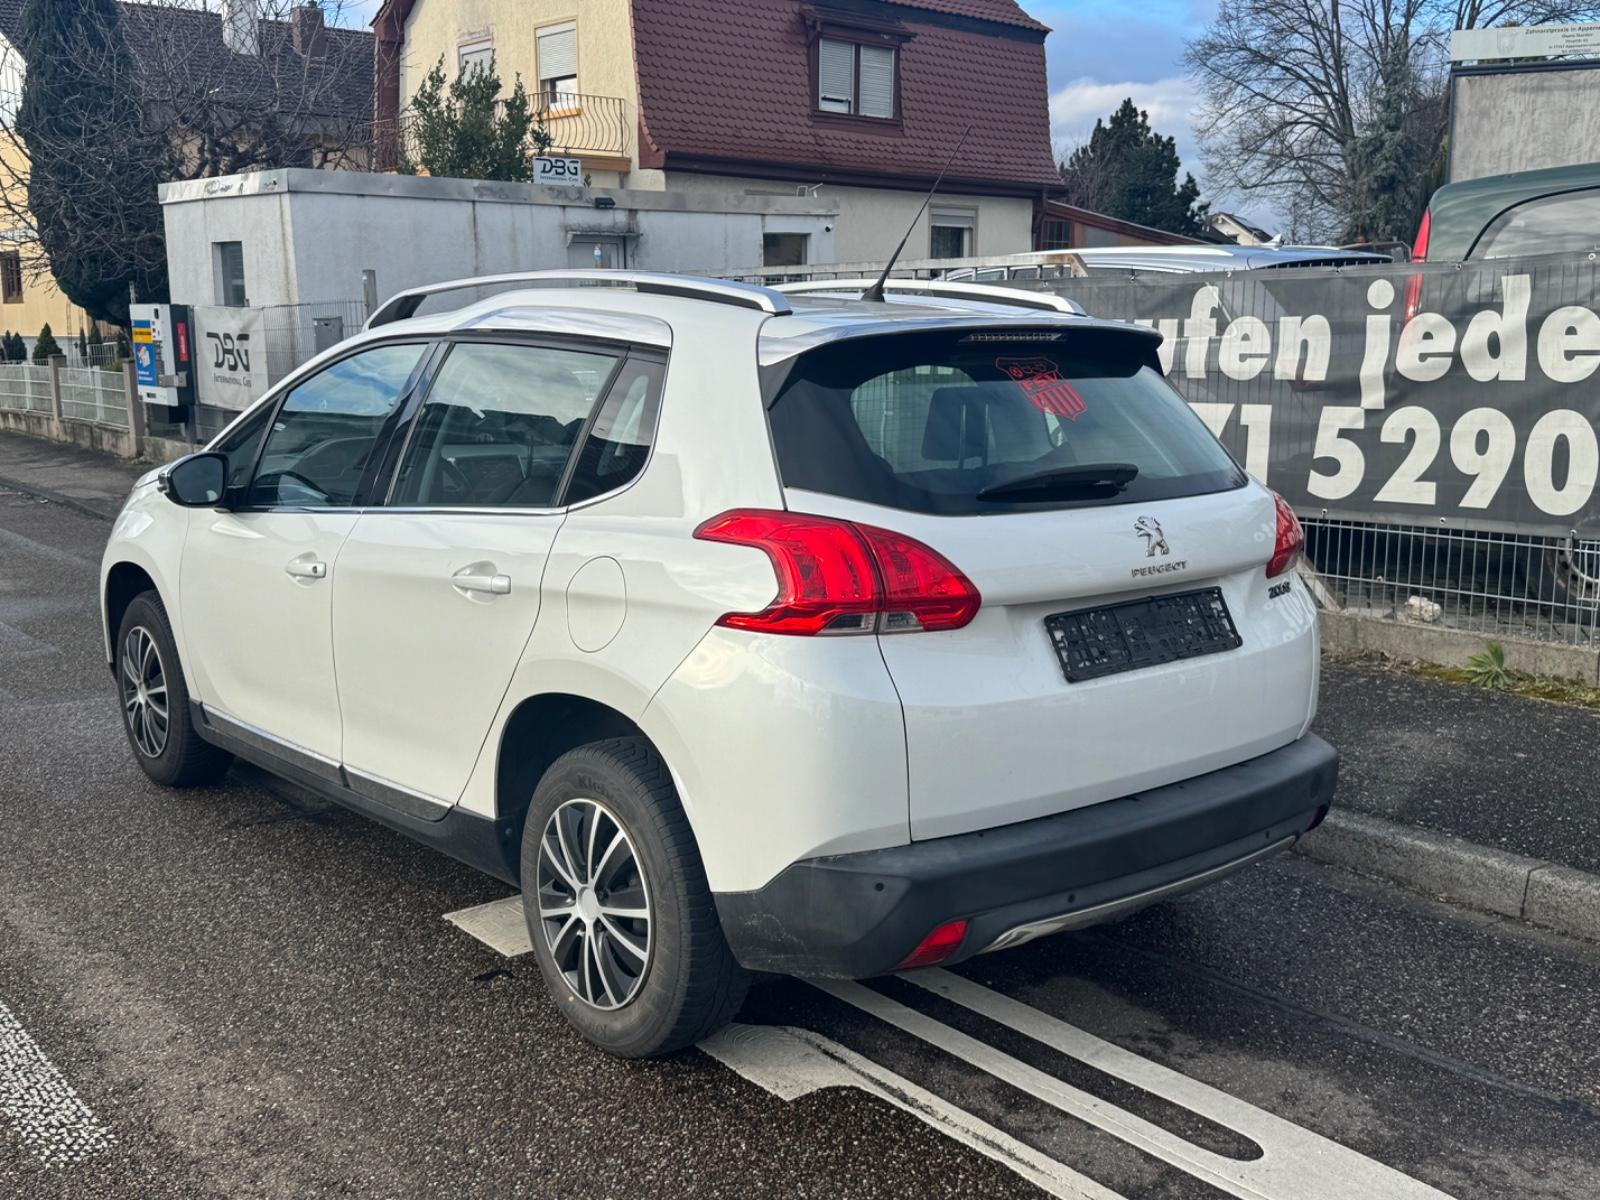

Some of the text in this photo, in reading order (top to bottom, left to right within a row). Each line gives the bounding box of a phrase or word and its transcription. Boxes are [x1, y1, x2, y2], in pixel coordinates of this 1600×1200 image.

[535, 158, 579, 176] DBG
[206, 331, 250, 372] DBG
[1112, 285, 1331, 381] ufen
[1307, 406, 1599, 516] 5290
[1131, 560, 1187, 578] PEUGEOT
